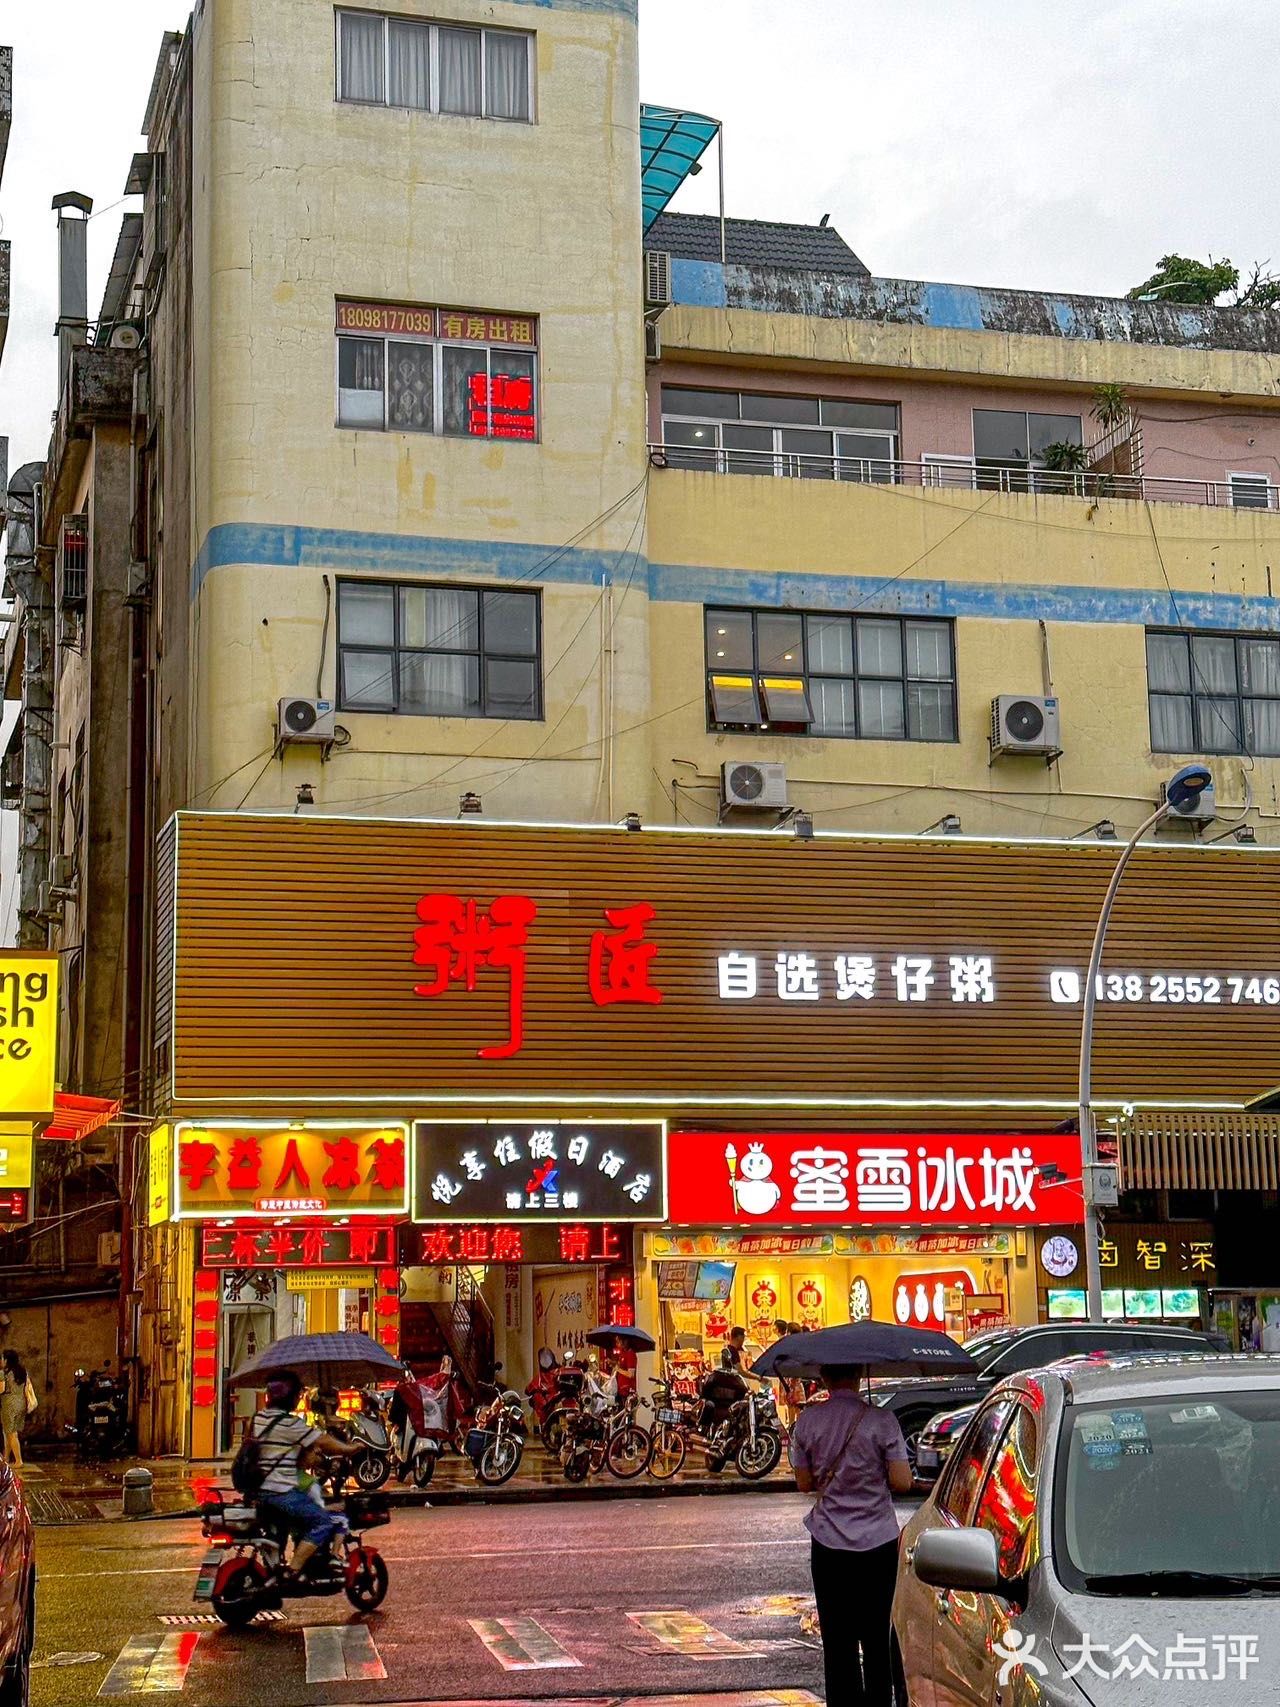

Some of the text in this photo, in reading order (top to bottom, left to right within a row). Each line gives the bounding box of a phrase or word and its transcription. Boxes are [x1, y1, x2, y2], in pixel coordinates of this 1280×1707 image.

[339, 307, 431, 332] 18098177039
[443, 315, 532, 343] 有房出租
[717, 953, 994, 1002] 自选煲仔粥
[1094, 974, 1143, 1001] 138
[1149, 976, 1221, 1003] 2552
[0, 1037, 32, 1060] e
[789, 1146, 1037, 1211] 蜜雪冰城
[505, 1193, 579, 1209] 请上三楼
[421, 1227, 620, 1262] 欢迎您 请上
[913, 1348, 951, 1357] C-STORE
